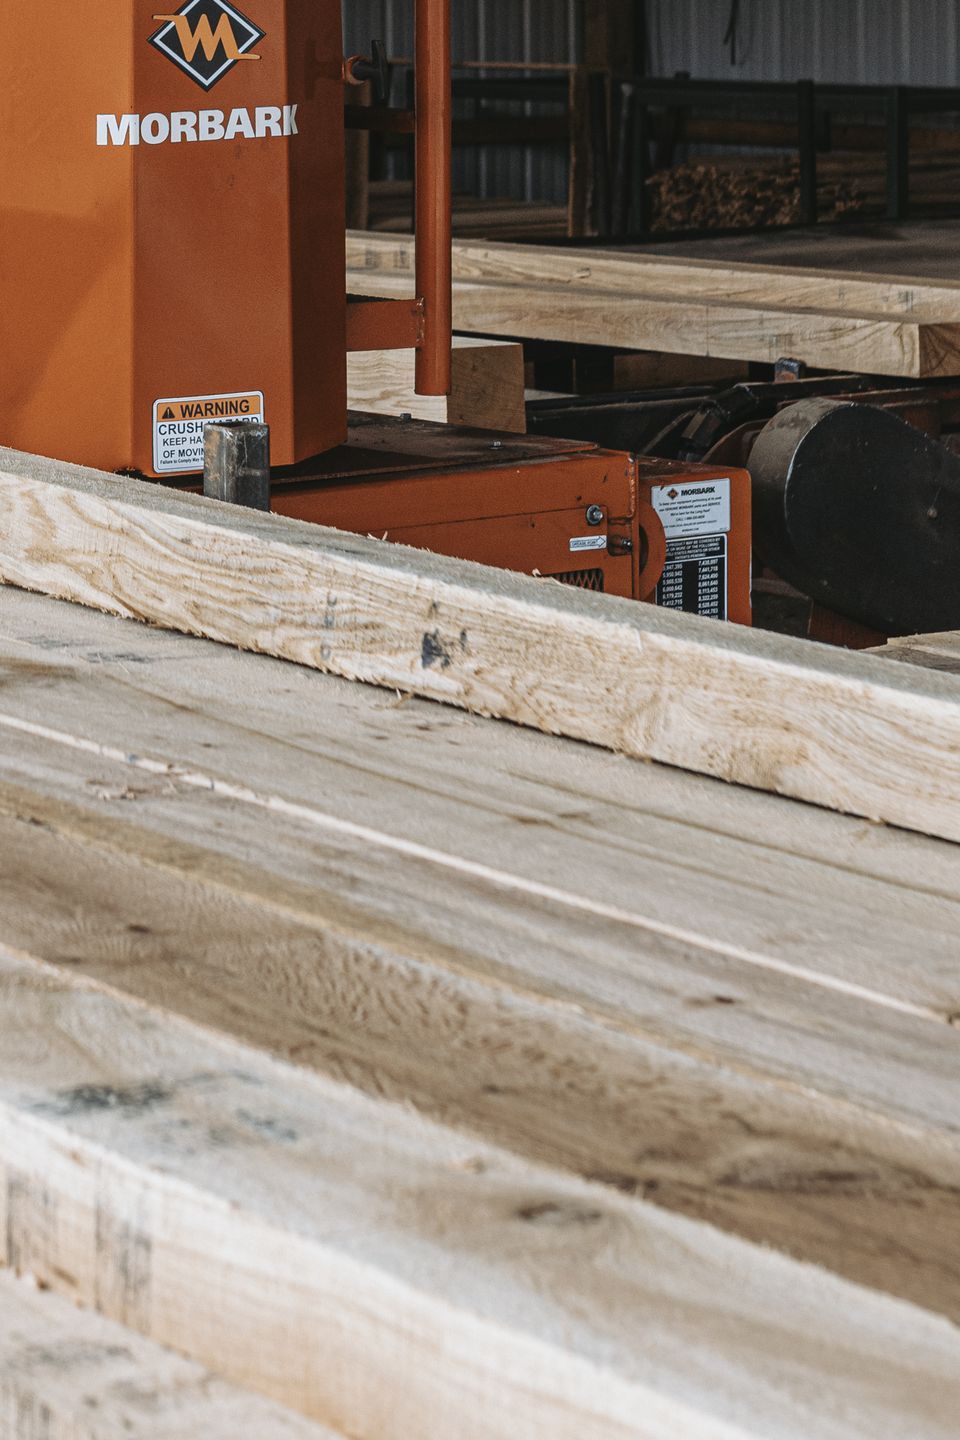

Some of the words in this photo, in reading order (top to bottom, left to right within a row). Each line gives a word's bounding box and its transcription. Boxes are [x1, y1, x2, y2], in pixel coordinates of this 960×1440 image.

[96, 104, 298, 146] MORBARK
[180, 400, 250, 418] WARNING
[159, 422, 203, 435] CRUSH
[163, 438, 186, 446] KEEP
[163, 450, 175, 458] OF
[178, 447, 204, 457] MOVIN
[681, 486, 715, 496] MORBARK
